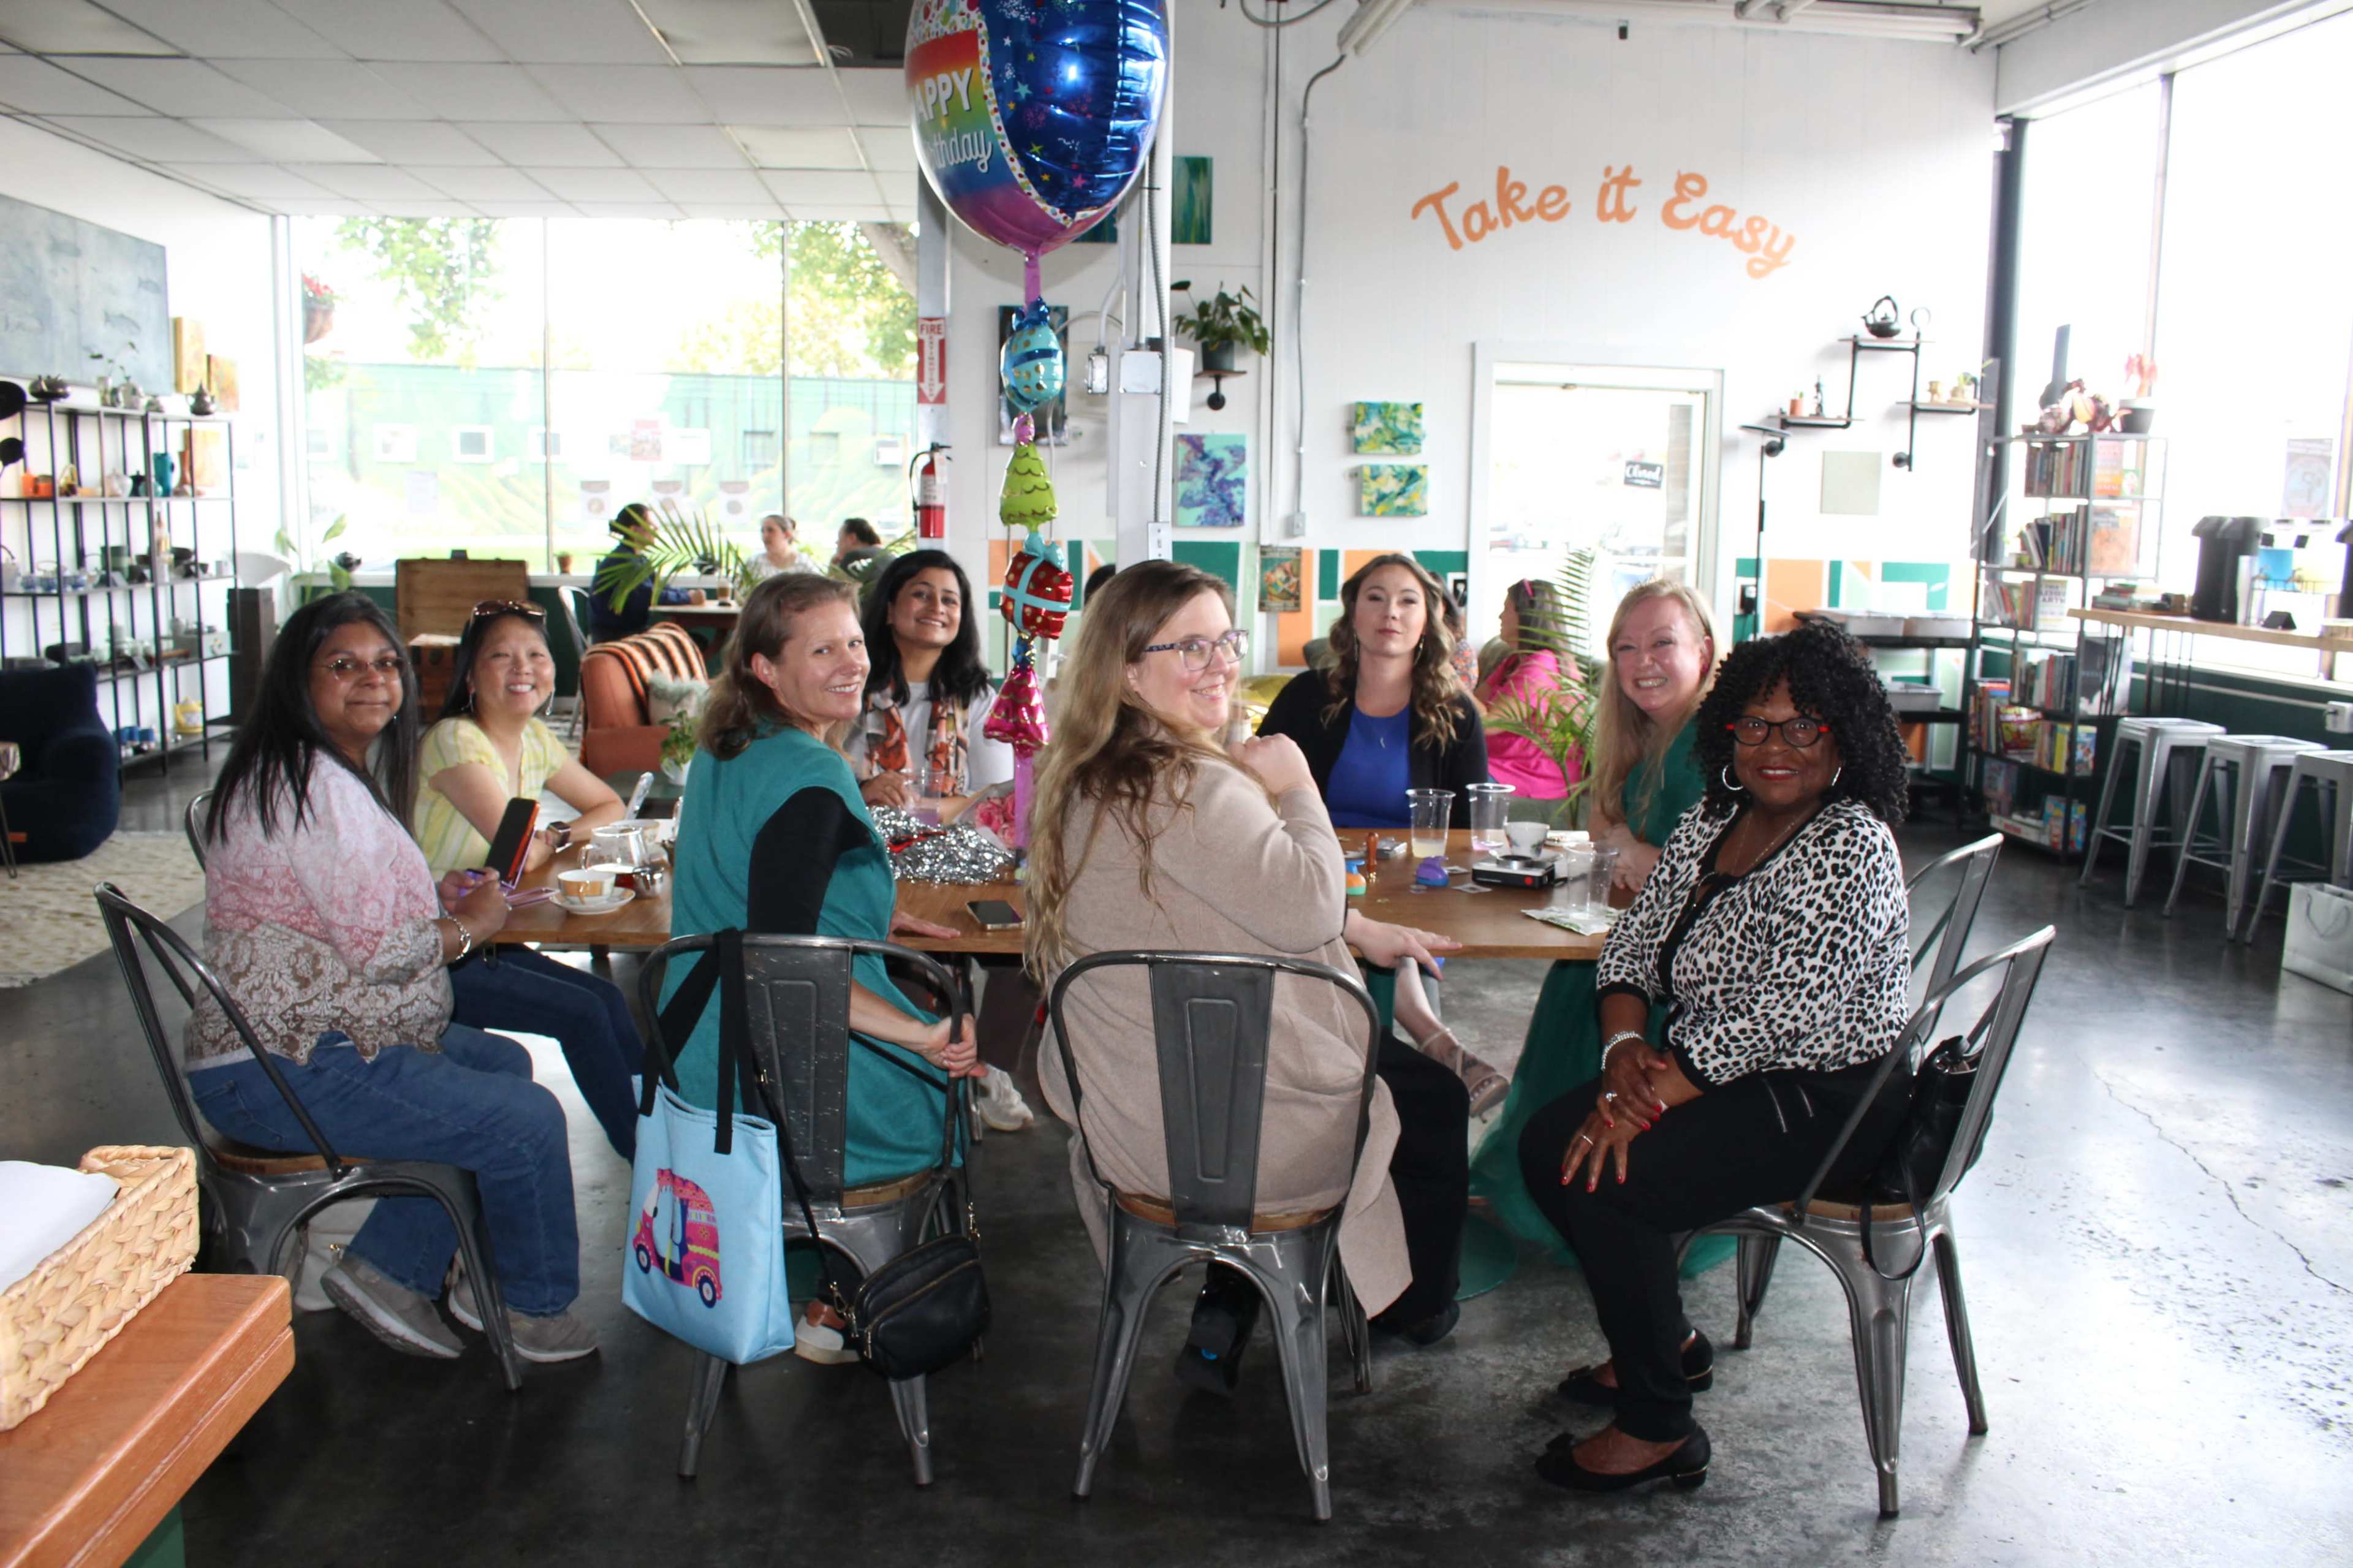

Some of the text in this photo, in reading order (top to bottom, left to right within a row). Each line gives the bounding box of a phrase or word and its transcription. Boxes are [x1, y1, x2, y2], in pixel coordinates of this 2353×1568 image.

[912, 68, 972, 121] APPY
[925, 127, 991, 173] rthday
[1411, 165, 1796, 279] Take it Easy
[920, 324, 942, 334] FIRE
